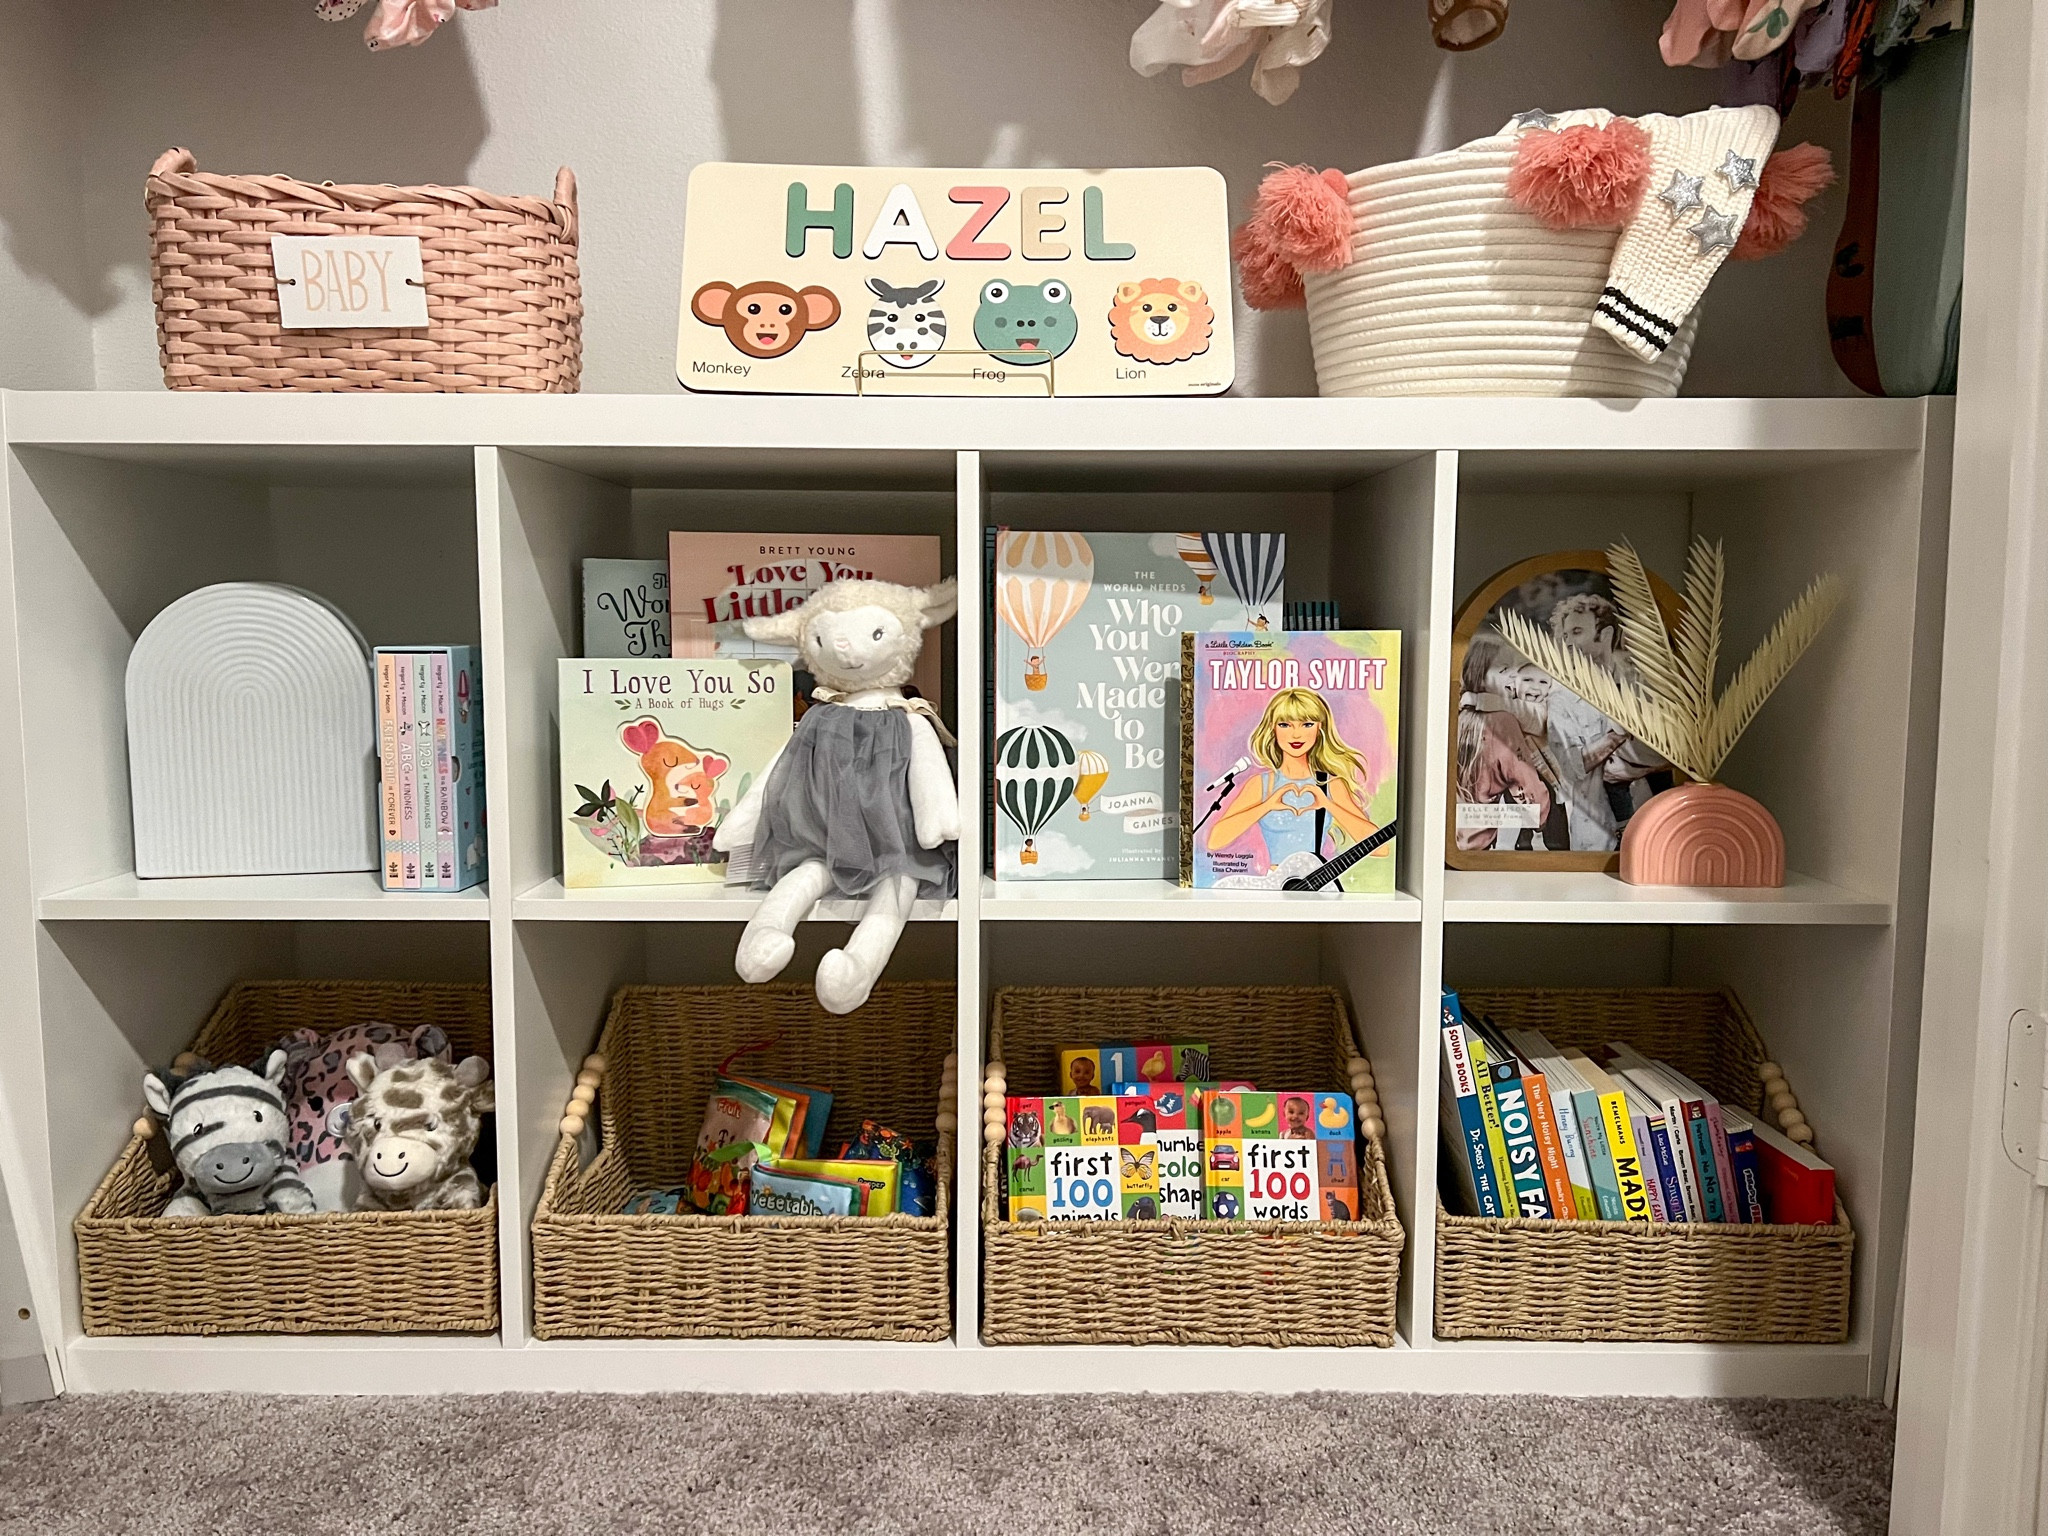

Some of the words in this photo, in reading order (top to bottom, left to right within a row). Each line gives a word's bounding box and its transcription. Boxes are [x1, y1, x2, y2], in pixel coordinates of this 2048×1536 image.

[786, 182, 1135, 261] HAZEL
[302, 250, 393, 313] BABY
[693, 361, 751, 377] Monkey
[841, 367, 885, 380] Zebra
[973, 368, 1006, 383] Frog
[1116, 368, 1146, 379] Lion
[760, 546, 800, 554] BRETT
[808, 547, 856, 556] YOUNG
[727, 564, 807, 586] Love
[1134, 571, 1156, 580] THE
[1103, 583, 1144, 592] WORLD
[1149, 583, 1186, 592] NEEDS
[702, 590, 804, 624] Little
[1107, 599, 1183, 637] Who
[1089, 624, 1149, 651] You
[1229, 641, 1253, 649] Golden
[583, 669, 592, 695] I
[610, 668, 672, 695] Love
[686, 669, 733, 695] You
[747, 671, 775, 694] So
[1209, 659, 1300, 690] TAYLOR
[1309, 659, 1387, 691] SWIFT
[635, 698, 643, 709] A
[648, 697, 674, 710] Book
[680, 697, 692, 709] of
[698, 697, 724, 710] Hugs
[1077, 683, 1166, 720] Made
[1109, 711, 1144, 740] to
[384, 719, 396, 784] FRIENDSHIP
[436, 719, 448, 774] HAPPINESS
[1125, 743, 1164, 769] Be
[403, 783, 412, 821] KINDNESS
[423, 782, 431, 829] THANKFULNESS
[440, 787, 448, 824] RAINBOW
[1108, 796, 1153, 809] JOANNA
[1133, 817, 1173, 829] GAINES
[1110, 1052, 1123, 1083] 1
[1448, 1029, 1463, 1060] SOUND
[1456, 1063, 1470, 1093] BOOKS
[1475, 1058, 1489, 1078] All
[1532, 1083, 1541, 1099] The
[717, 1097, 742, 1119] Fruit
[1481, 1084, 1500, 1129] Better!
[1536, 1100, 1546, 1120] Very
[1540, 1121, 1553, 1146] Noisy
[1559, 1108, 1569, 1131] Honey
[1565, 1133, 1575, 1158] Bunny
[1611, 1101, 1626, 1145] BEMELMANS
[1470, 1129, 1480, 1142] Dr.
[1498, 1089, 1541, 1182] NOISY
[1583, 1116, 1597, 1159] Sunshine
[1598, 1132, 1603, 1140] My
[1051, 1152, 1113, 1176] first
[1248, 1144, 1310, 1168] first
[1702, 1161, 1709, 1172] No
[858, 1177, 886, 1190] Ppper
[1052, 1178, 1113, 1208] 100
[1250, 1169, 1311, 1200] 100
[1479, 1175, 1490, 1191] THE
[1554, 1179, 1563, 1203] Hendry
[1646, 1178, 1659, 1204] HAPPY
[1706, 1176, 1716, 1193] No
[752, 1191, 822, 1216] Vegetable
[1160, 1183, 1202, 1209] shap
[1483, 1195, 1495, 1215] CAT
[1665, 1177, 1683, 1222] Snuggle
[1709, 1200, 1717, 1214] Yes
[1050, 1209, 1118, 1221] animals
[1254, 1202, 1309, 1219] words
